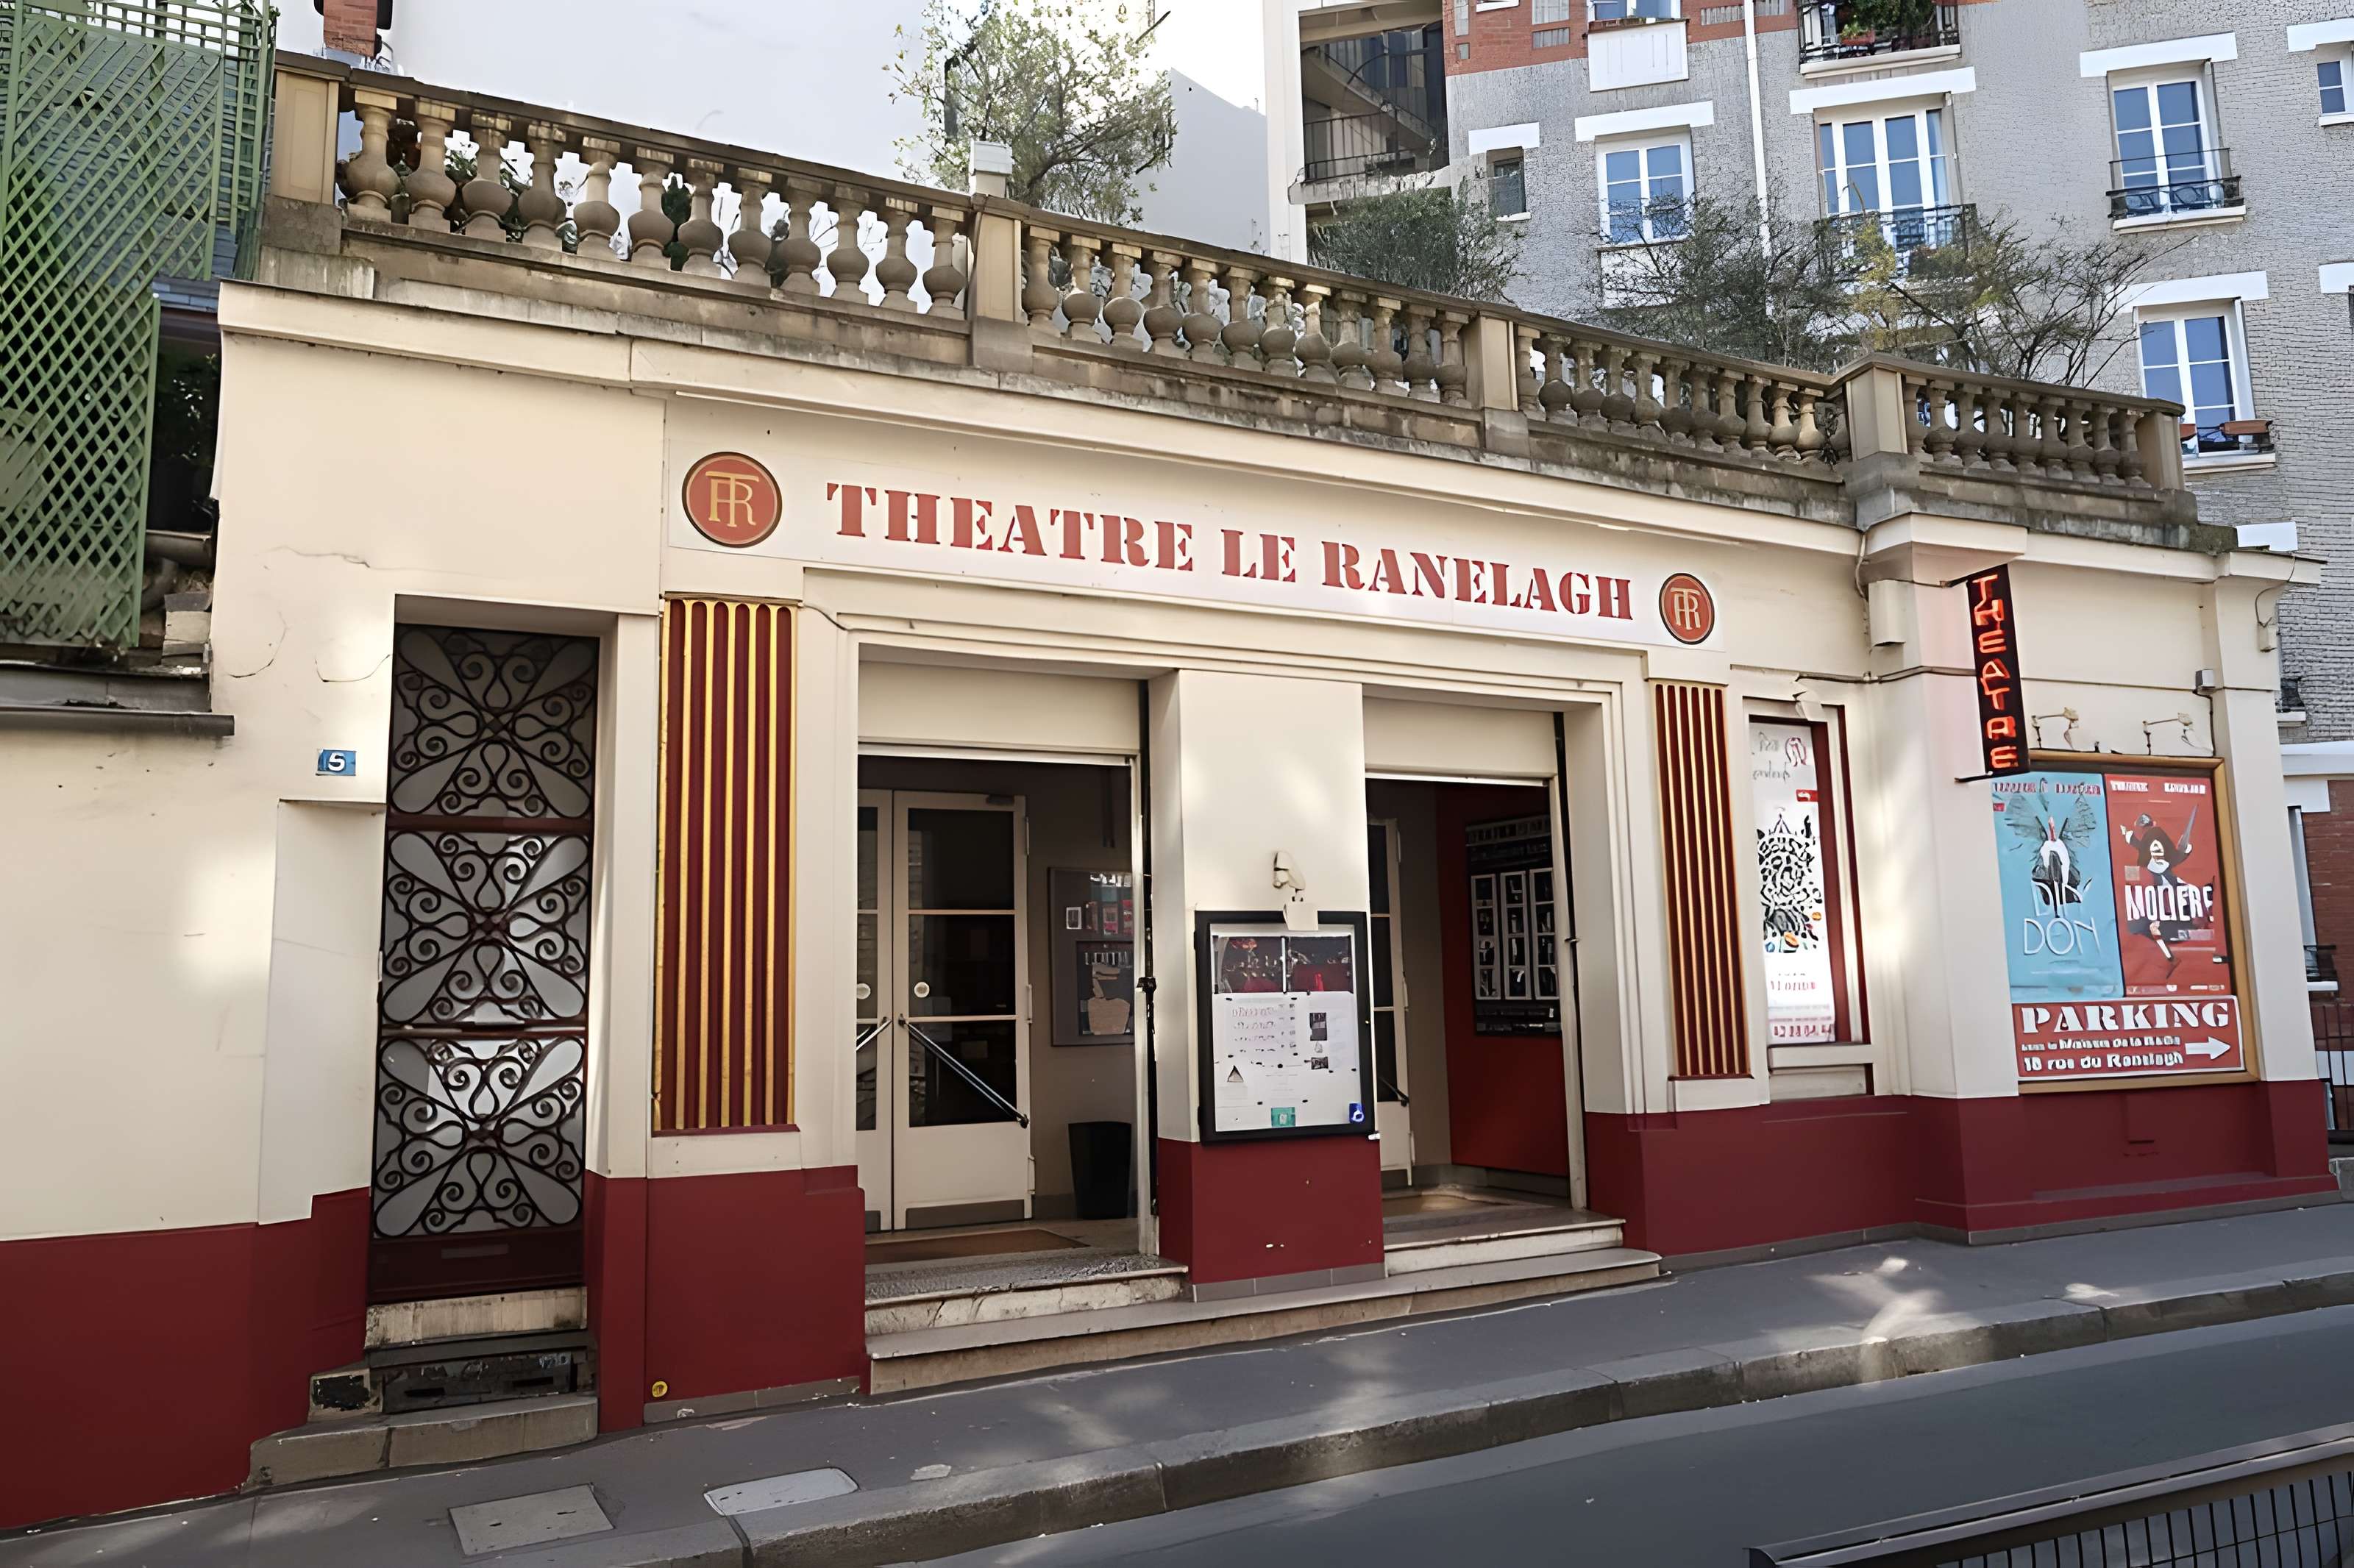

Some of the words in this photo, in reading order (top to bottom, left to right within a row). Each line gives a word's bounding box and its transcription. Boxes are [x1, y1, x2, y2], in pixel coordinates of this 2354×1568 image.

[827, 482, 1193, 571] THEATRE
[1222, 530, 1296, 582] LE
[1322, 541, 1632, 620] RANELAGH
[1972, 574, 2019, 769] THEATRE
[328, 752, 345, 771] 5
[2021, 1002, 2229, 1033] PARKING
